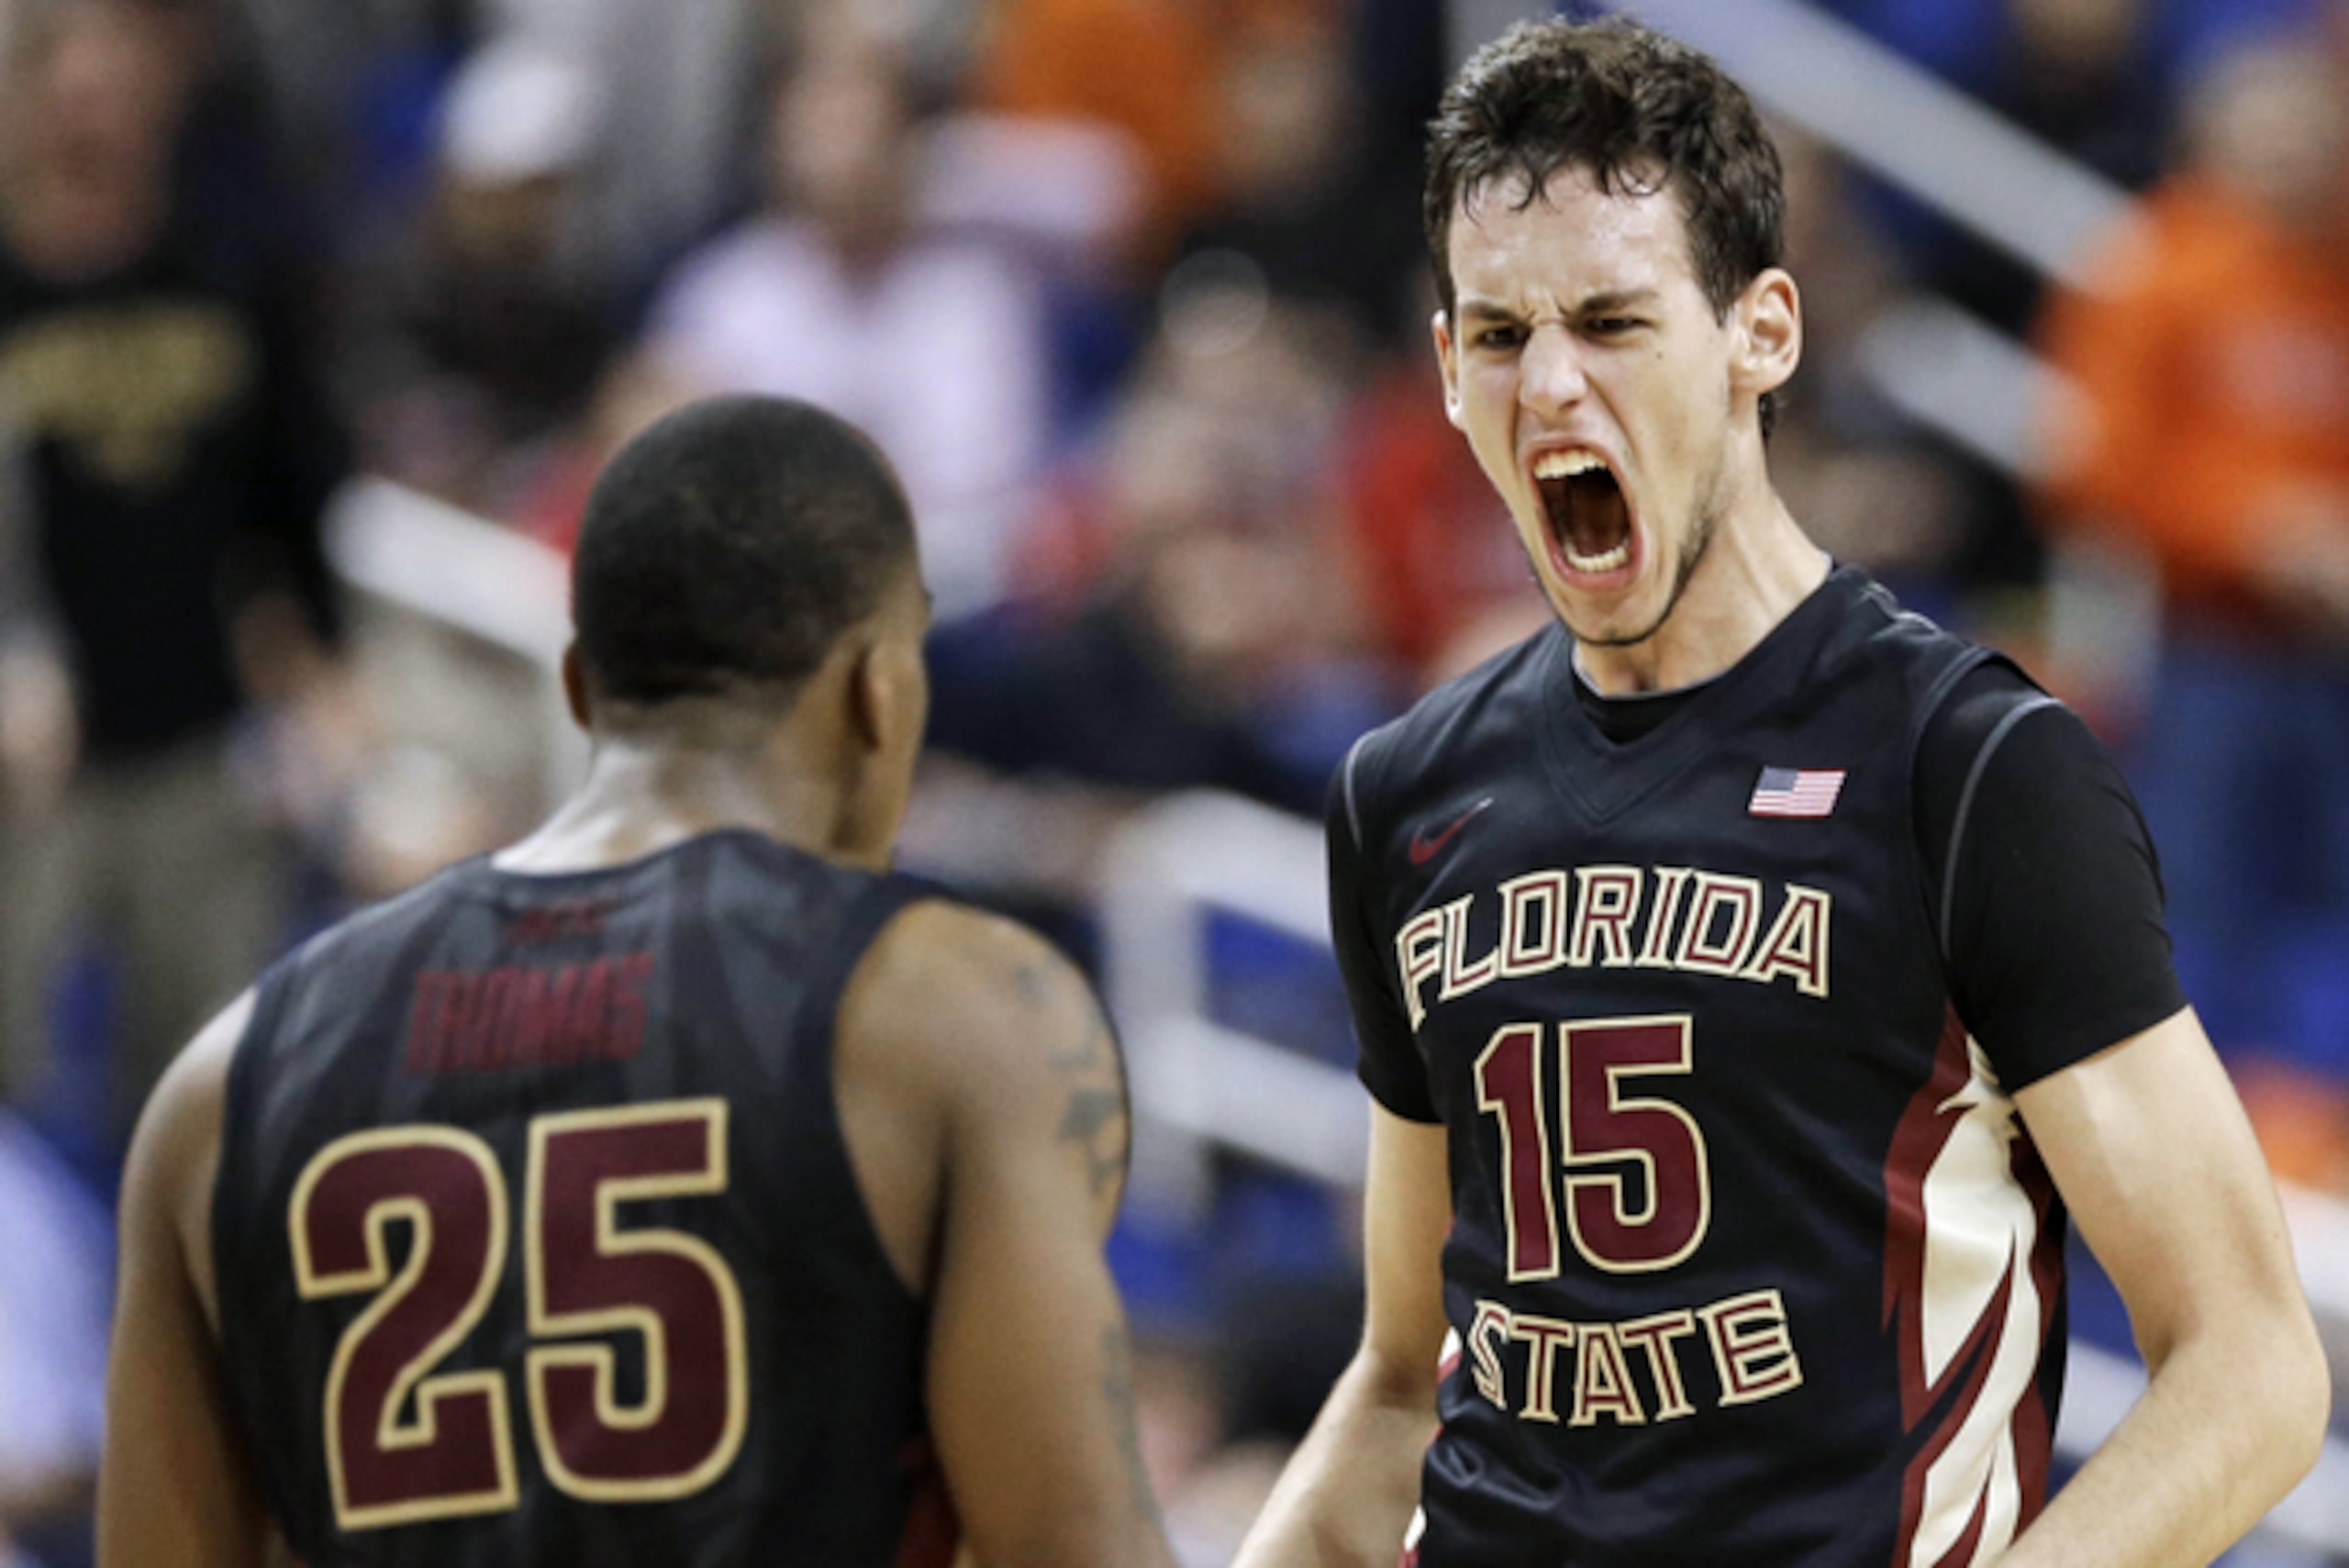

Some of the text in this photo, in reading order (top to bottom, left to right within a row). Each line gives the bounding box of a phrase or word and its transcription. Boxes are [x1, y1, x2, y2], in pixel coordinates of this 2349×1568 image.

[406, 952, 654, 1073] THOMAS
[1397, 865, 1831, 1032] FLORIDA
[1474, 1014, 1710, 1283] 15
[288, 1097, 749, 1530] 25
[1470, 1289, 1804, 1427] STATE
